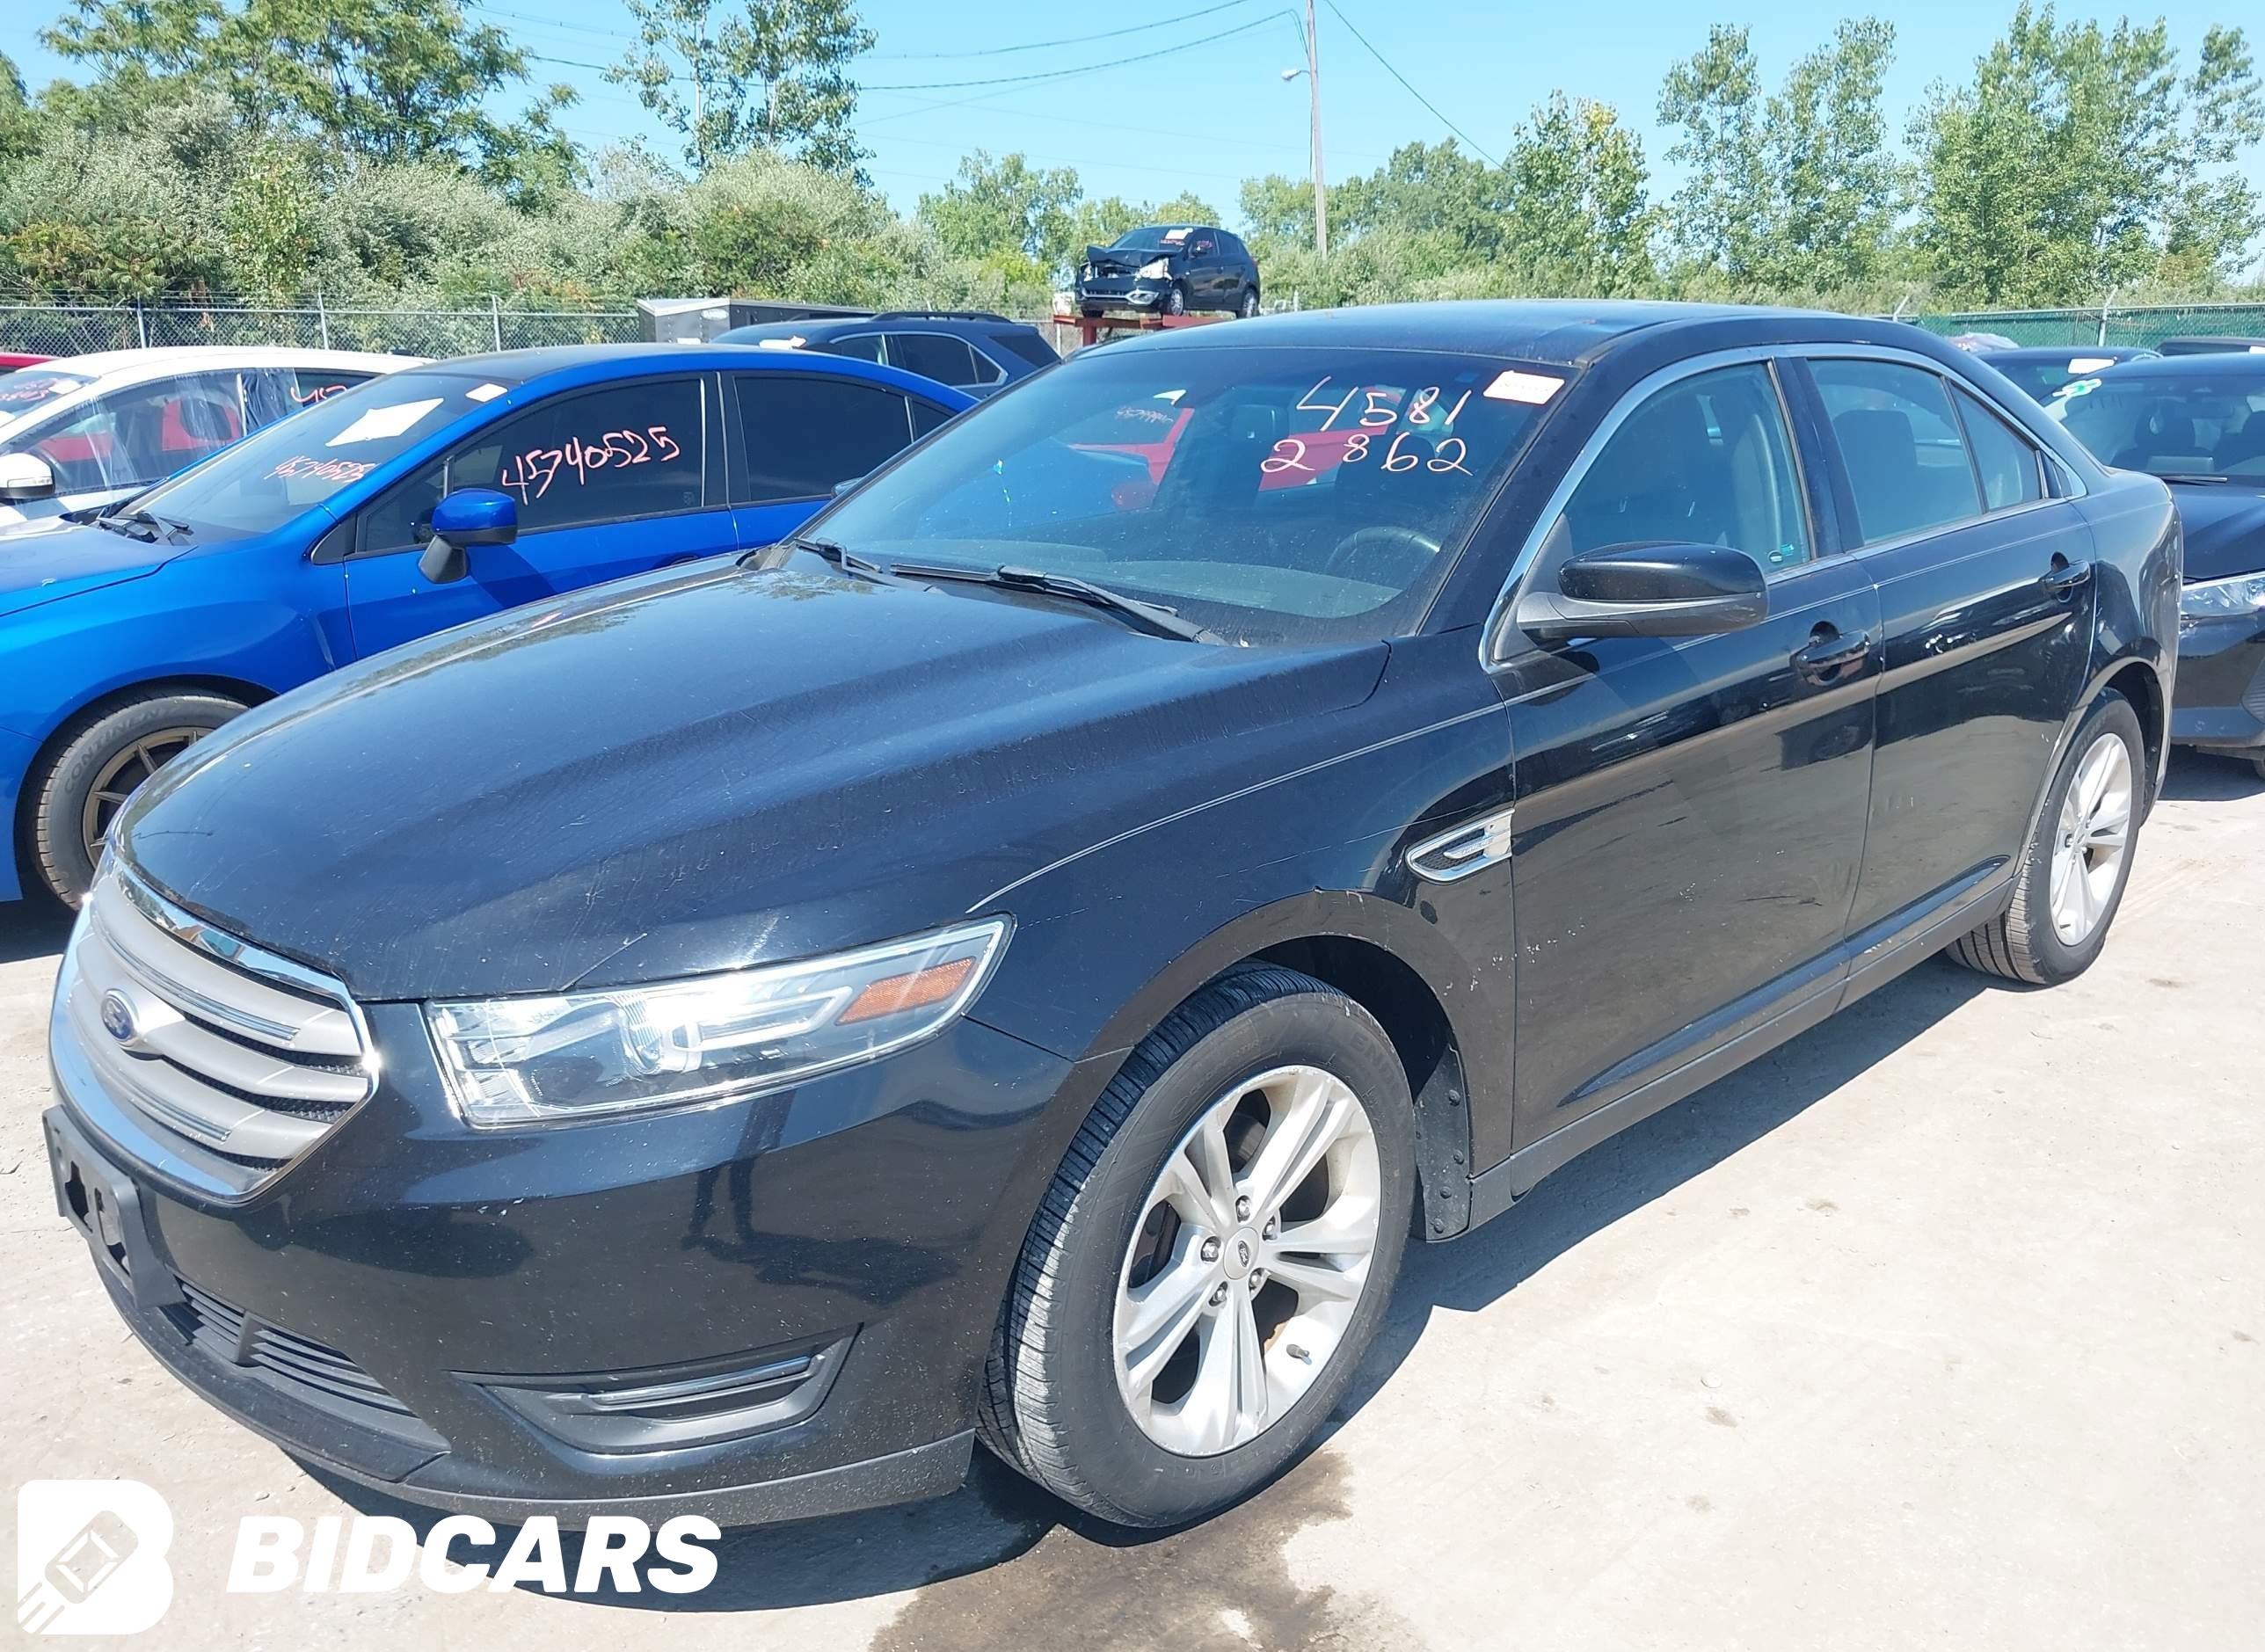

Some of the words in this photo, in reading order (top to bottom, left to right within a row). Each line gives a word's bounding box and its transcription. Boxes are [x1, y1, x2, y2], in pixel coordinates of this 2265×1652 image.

[1296, 375, 1472, 432] 4581
[501, 426, 681, 506] 45740525
[1260, 432, 1474, 477] 2862
